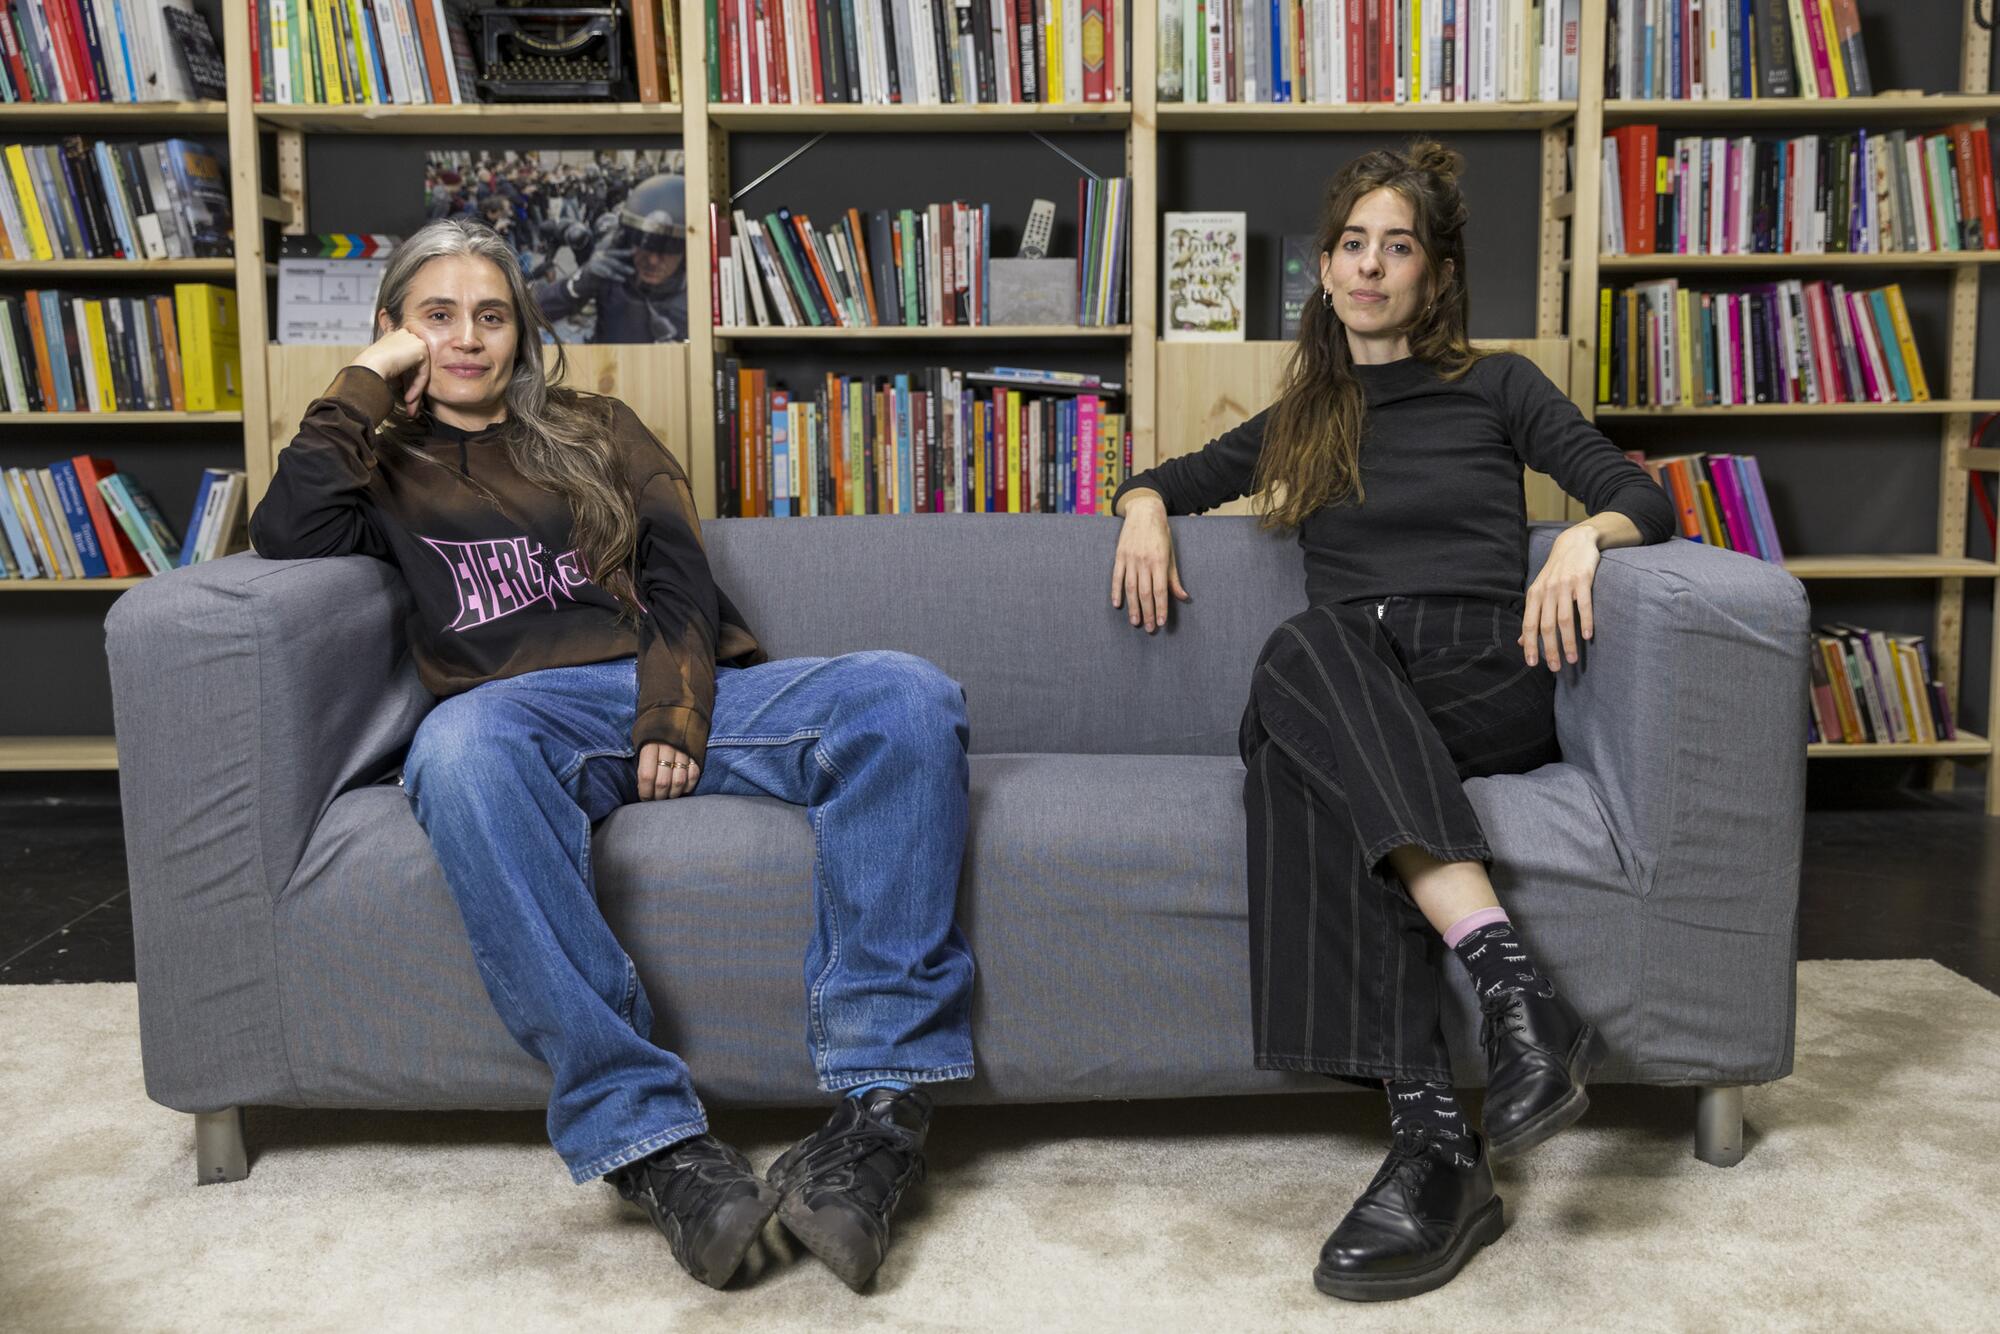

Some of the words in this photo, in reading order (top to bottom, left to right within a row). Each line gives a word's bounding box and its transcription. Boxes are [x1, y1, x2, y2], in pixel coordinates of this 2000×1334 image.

[1081, 418, 1093, 486] INCORREGIBLES
[1105, 436, 1116, 500] TOTAL
[1081, 487, 1091, 505] LOS
